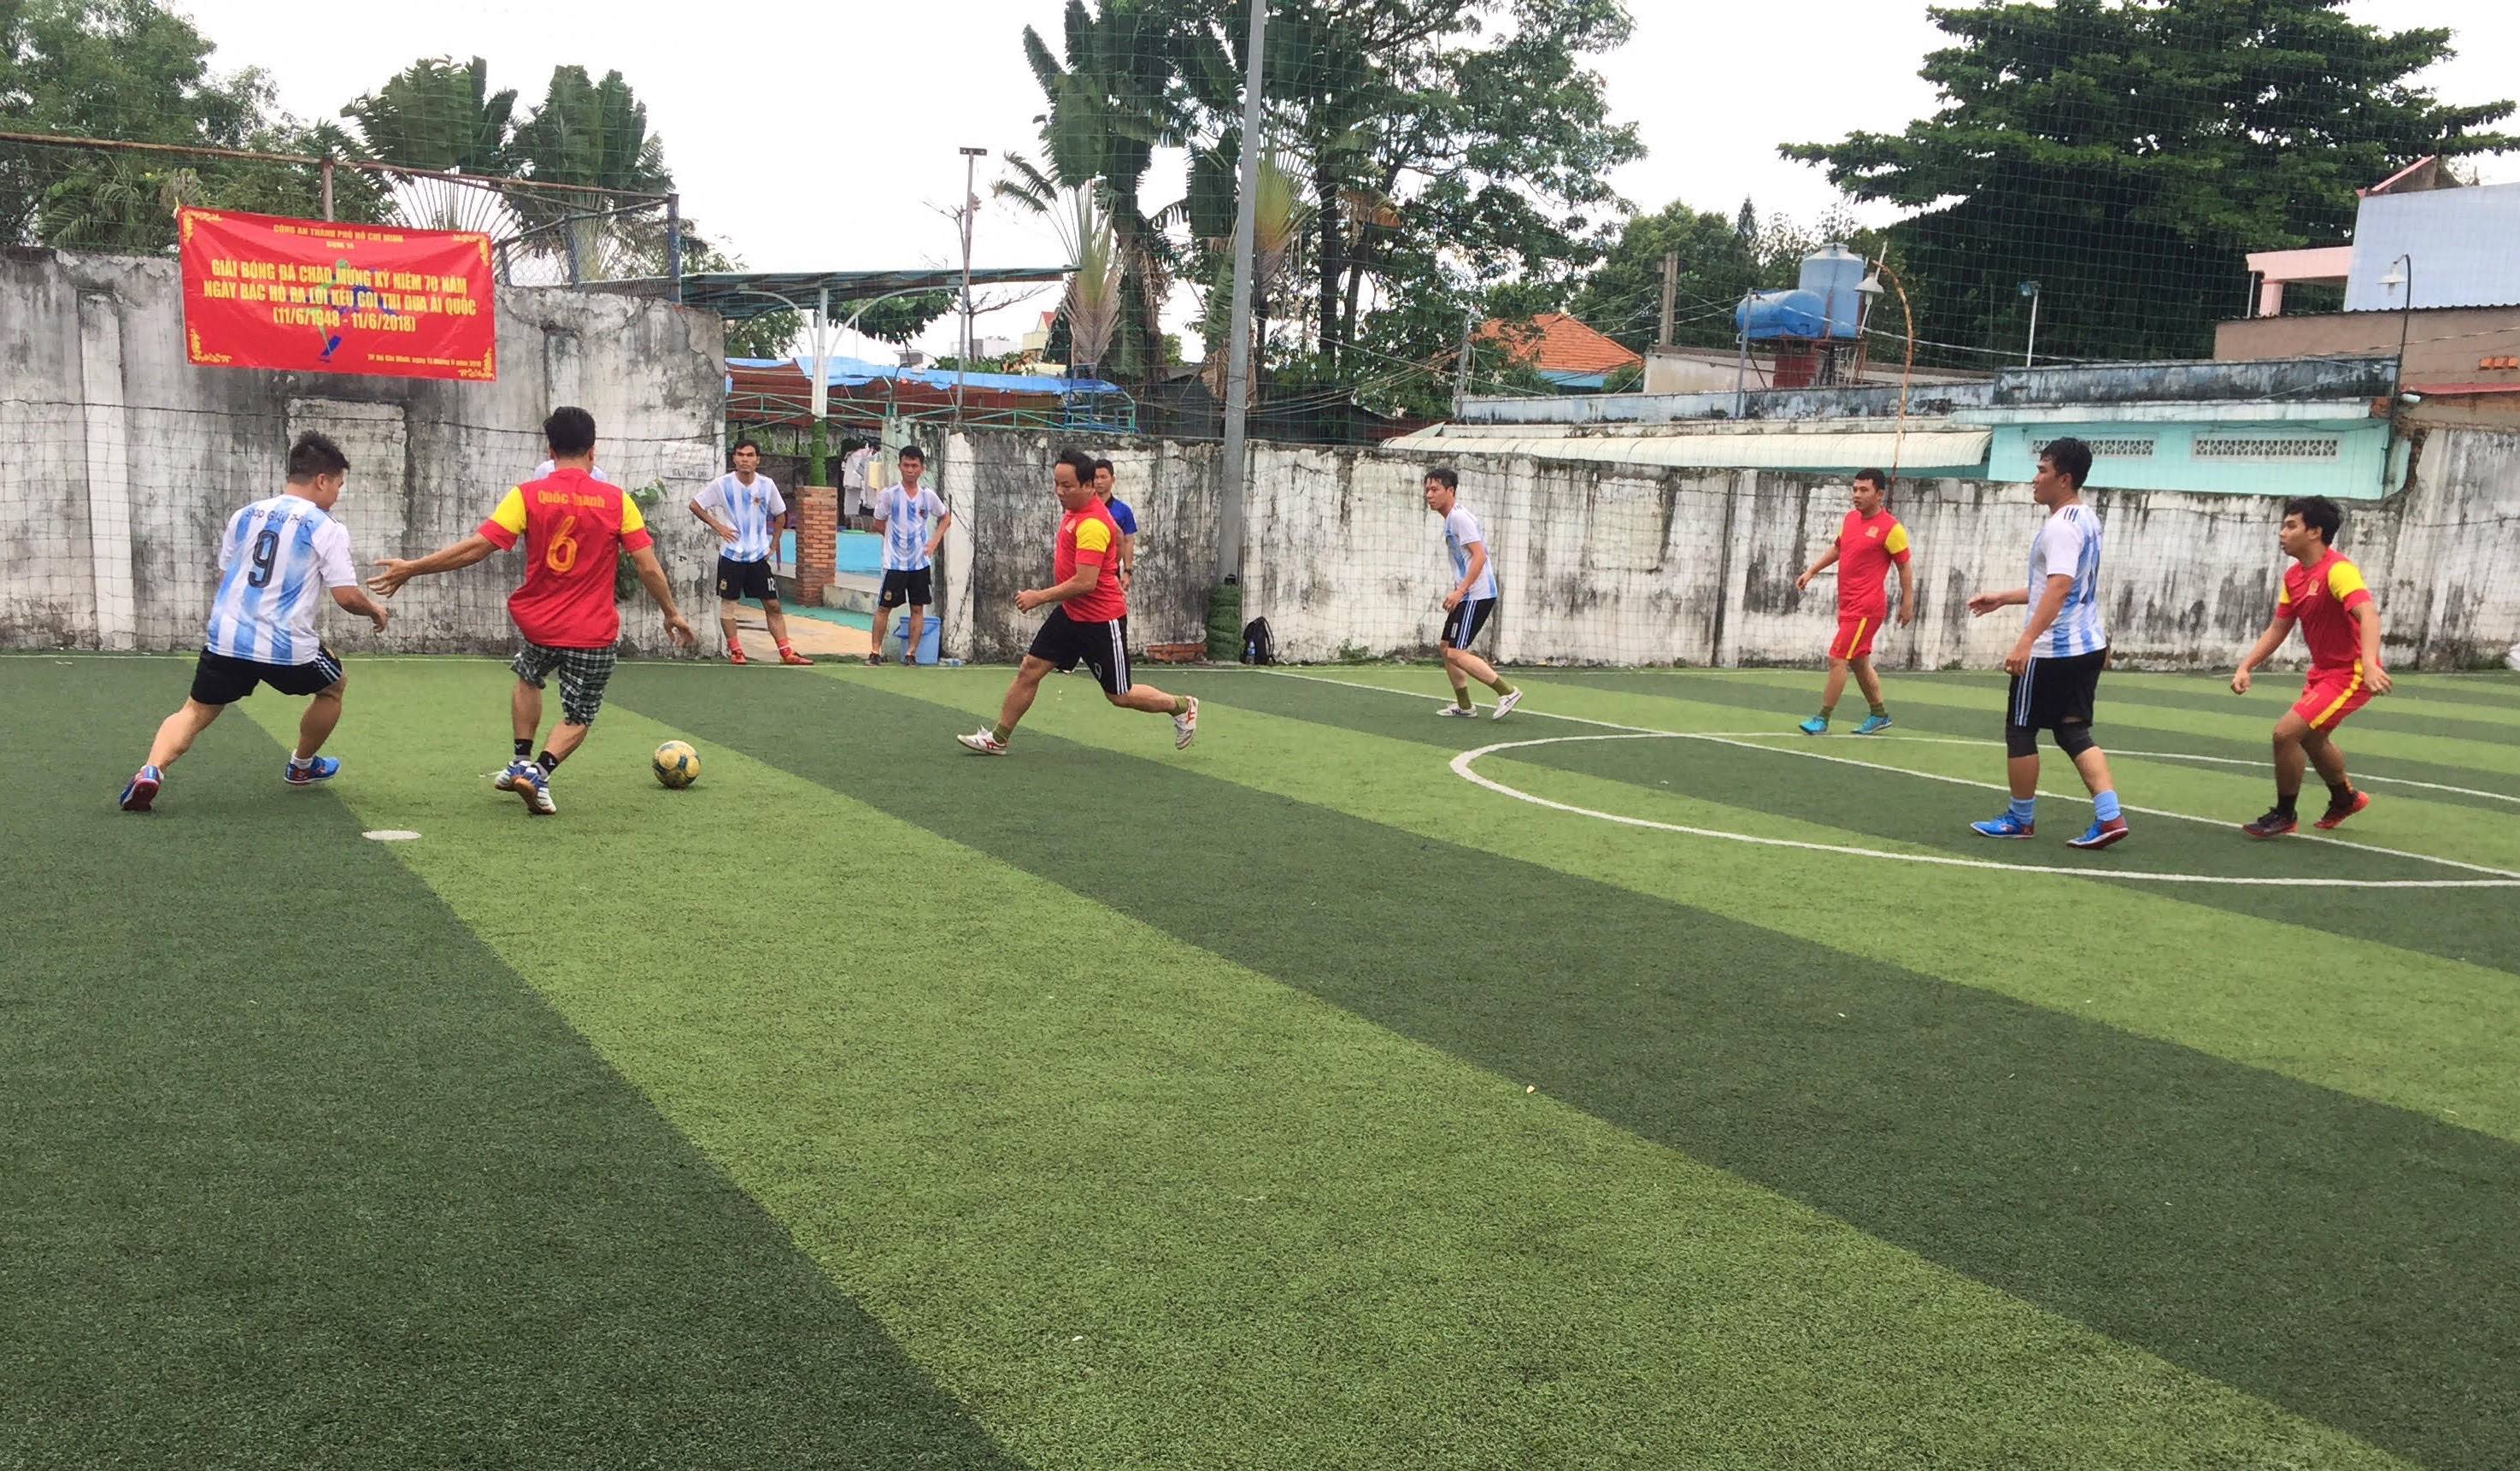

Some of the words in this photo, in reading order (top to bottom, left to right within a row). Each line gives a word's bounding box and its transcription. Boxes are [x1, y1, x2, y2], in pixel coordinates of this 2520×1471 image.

[273, 224, 296, 234] CÔNG
[297, 227, 308, 235] AN
[310, 227, 335, 238] THÀNH
[355, 231, 366, 240] HỒ
[211, 256, 238, 277] GIẢI
[241, 260, 275, 280] BÓNG
[279, 262, 297, 281] ĐÁ
[299, 264, 332, 284] CHÀO
[393, 271, 422, 292] NIỆM
[424, 275, 438, 292] 70
[442, 275, 467, 294] NĂM
[203, 280, 236, 299] NGÀY
[239, 280, 266, 301] BÁC
[268, 282, 286, 303] HỒ
[289, 285, 306, 303] RA
[331, 286, 354, 307] KÊU
[357, 291, 379, 311] GỌI
[381, 292, 402, 310] THI
[404, 294, 427, 313] ĐUA
[430, 294, 443, 314] ÁI
[445, 295, 477, 315] QUỐC
[273, 307, 340, 327] (11/6/1948
[351, 312, 416, 332] 11/6/2018)
[248, 530, 279, 588] 9
[547, 515, 578, 573] 6
[767, 577, 776, 591] 12
